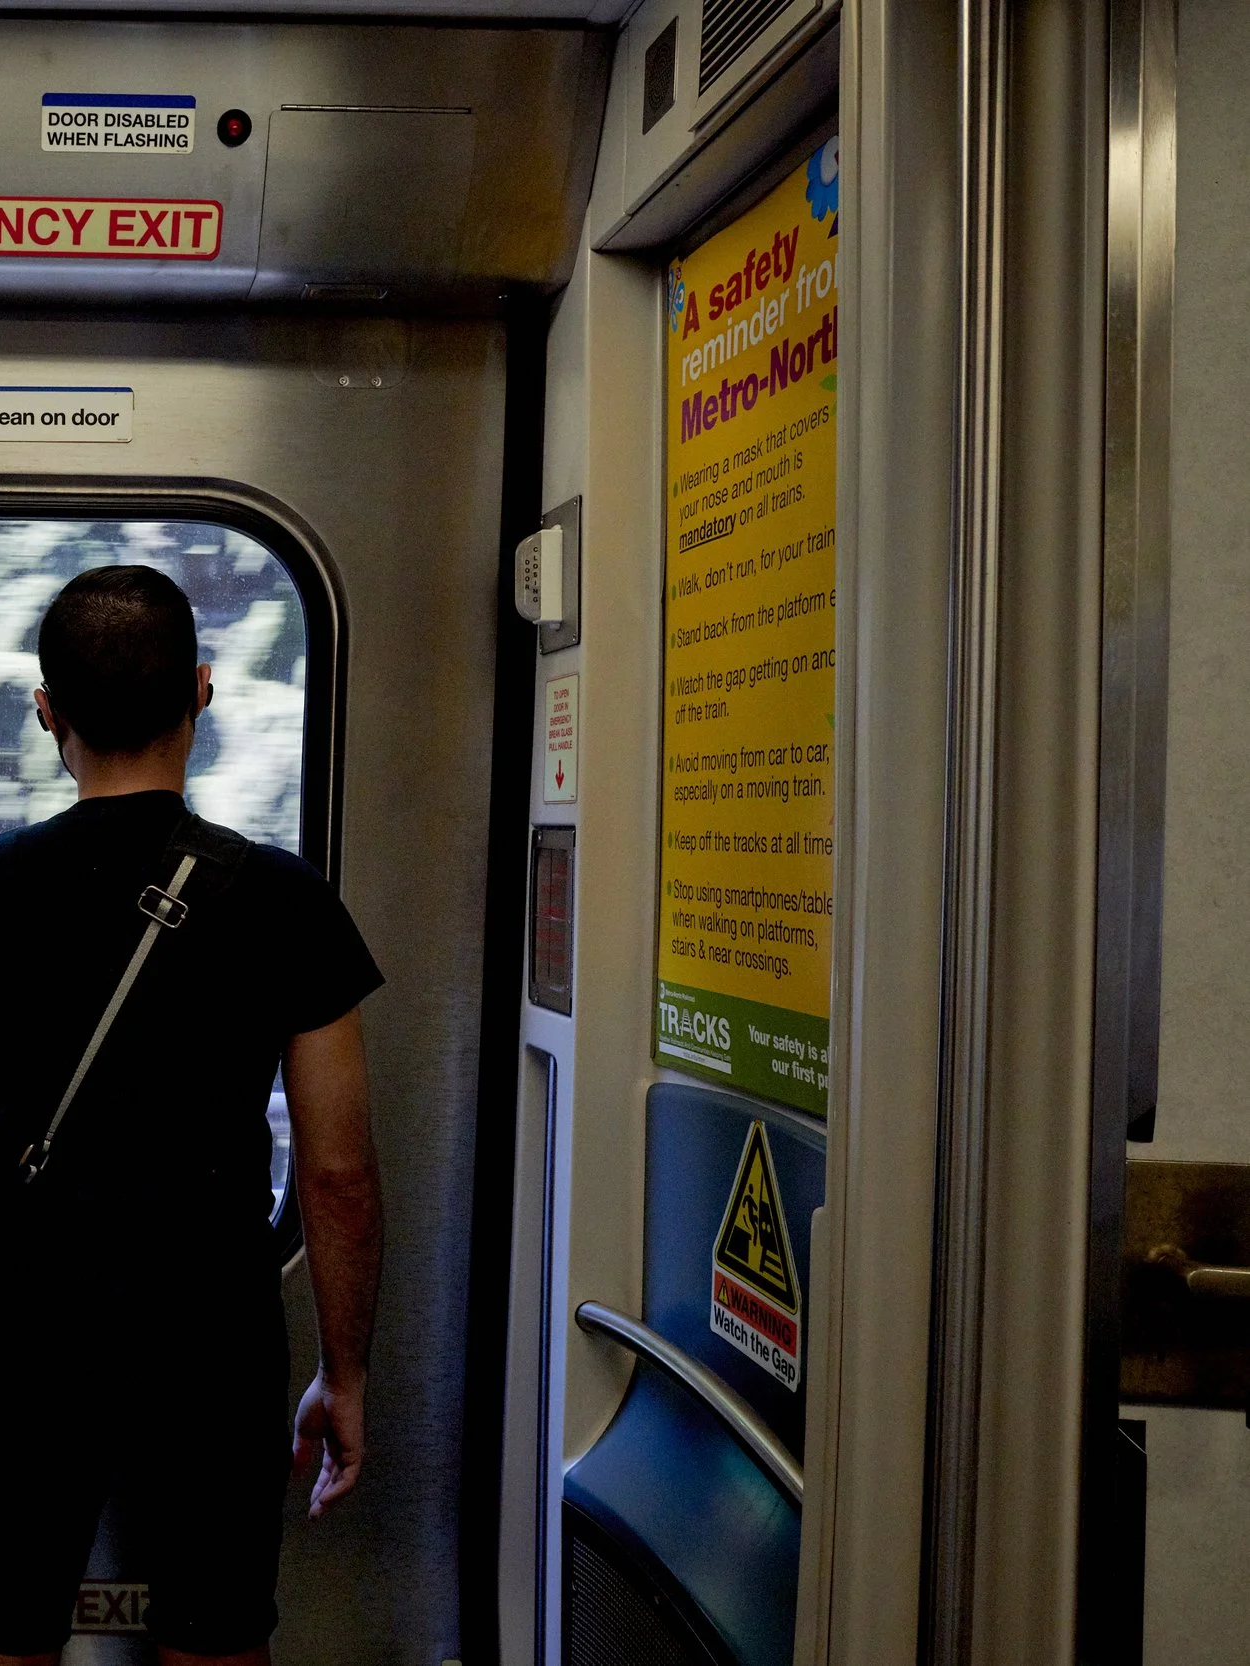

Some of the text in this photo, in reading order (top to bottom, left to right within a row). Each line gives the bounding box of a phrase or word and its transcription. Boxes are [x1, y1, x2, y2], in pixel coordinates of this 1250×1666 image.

[47, 132, 188, 148] WHEN FLASHING
[49, 113, 189, 128] DOOR DISABLED
[108, 210, 212, 249] EXIT
[683, 225, 799, 341] A safety
[681, 254, 838, 387] reminder fro
[41, 412, 65, 425] on
[72, 408, 119, 426] door
[680, 405, 829, 494] Wearing a mask that covers
[679, 449, 803, 527] your nose and mouth is
[680, 484, 805, 550] mandatory on all trains.
[678, 574, 702, 598] Walk,
[705, 562, 733, 589] don't
[736, 558, 757, 579] run,
[760, 548, 775, 570] for
[778, 540, 803, 570] your
[677, 624, 701, 648] Stand
[704, 616, 729, 641] back
[731, 612, 755, 634] from
[757, 604, 774, 627] the
[777, 591, 825, 627] platform
[677, 671, 704, 696] Watch
[707, 670, 723, 690] the
[726, 668, 746, 692] gap
[749, 656, 788, 688] getting
[792, 654, 808, 674] on
[675, 698, 729, 725] off the train.
[675, 742, 830, 774] Avoid moving from car to car,
[674, 774, 825, 805] especially on a moving train.
[675, 830, 833, 855] Keep off the tracks at all time
[674, 879, 833, 915] Stop using smartphones/table
[673, 907, 818, 951] when walking on platforms,
[671, 936, 792, 979] stairs & near crossings.
[659, 1002, 731, 1051] TRACKS
[748, 1024, 770, 1046] Your
[772, 1035, 805, 1060] safety
[807, 1041, 818, 1061] is
[772, 1057, 790, 1076] our
[792, 1060, 815, 1083] first
[730, 1286, 791, 1346] WARNING
[714, 1304, 796, 1383] Watch the Gap
